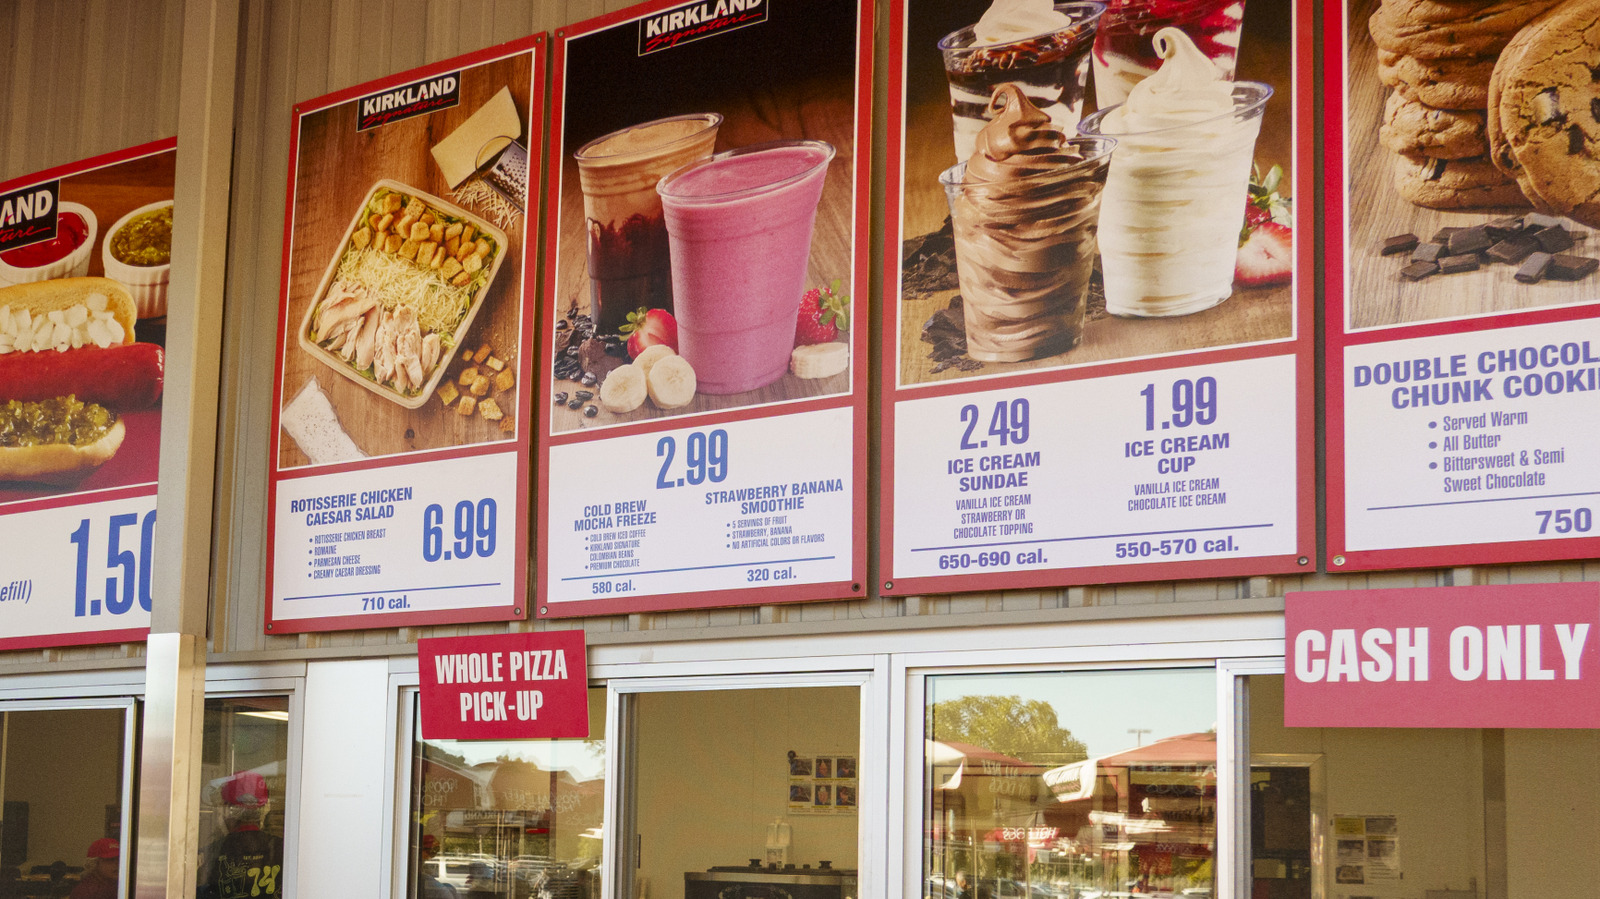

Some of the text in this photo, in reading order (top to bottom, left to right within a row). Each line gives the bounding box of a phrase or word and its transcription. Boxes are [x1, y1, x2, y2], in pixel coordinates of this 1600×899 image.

[646, 12, 762, 52] Signature
[363, 77, 456, 116] KIRKLAND
[362, 98, 455, 129] Signature
[1353, 354, 1467, 387] DOUBLE
[1391, 367, 1600, 409] CHUNK COOKI
[1139, 376, 1217, 431] 1.99
[960, 398, 1030, 450] 2.49
[1443, 411, 1528, 431] Served Warm
[1125, 433, 1229, 457] ICE CREAM
[1443, 433, 1501, 451] All Butter
[656, 428, 728, 490] 2.99
[948, 451, 1040, 474] ICE CREAM
[1158, 456, 1195, 474] CUP
[1443, 447, 1565, 472] Bittersweet & Semi
[959, 471, 1028, 492] SUNDAE
[1134, 477, 1220, 495] VANILLA ICE CREAM
[1443, 471, 1546, 493] Sweet Chocolate
[291, 486, 412, 513] ROTISSERIE CHICKEN
[705, 478, 843, 505] STRAWBERRY BANANA
[584, 500, 647, 518] COLD BREW
[741, 497, 804, 515] SMOOTHIE
[956, 494, 1031, 510] VANILLA ICE CREAM
[1128, 492, 1226, 511] CHOCOLATE ICE CREAM
[306, 504, 394, 526] CAESAR SALAD
[574, 512, 657, 531] MOCHA FREEZE
[732, 515, 787, 528] 5 SERVINGS OF FRUIT
[961, 508, 1025, 524] STRAWBERRY OR
[1534, 507, 1592, 535] 750
[315, 528, 386, 544] ROTISSERIE CHICKEN BREAST
[423, 497, 497, 562] 6.99
[590, 529, 646, 542] COLD BREW ICED COFFEE
[732, 526, 792, 539] STRAWBERRY, BANANA
[953, 522, 1033, 539] CHOCOLATE TOPPING
[314, 545, 337, 556] ROMAINE
[590, 539, 640, 552] KIRKLAND SIGNATURE
[732, 533, 824, 549] NO ARTIFICIAL COLORS OR FLAVORS
[1115, 535, 1239, 558] 550-570 cal.
[313, 555, 361, 567] PARMESAN CHEESE
[590, 549, 634, 561] COLOMBIAN BEANS
[939, 548, 1048, 570] 650-690 cal.
[313, 565, 381, 579] CREAMY CAESAR DRESSING
[590, 559, 640, 571] PREMIUM CHOCOLATE
[746, 567, 797, 583] 320 cal.
[592, 580, 636, 594] 580 cal.
[361, 595, 411, 611] 710 cal.
[1294, 623, 1591, 683] CASH ONLY
[434, 649, 568, 684] WHOLE PIZZA
[459, 690, 544, 722] PICK-UP
